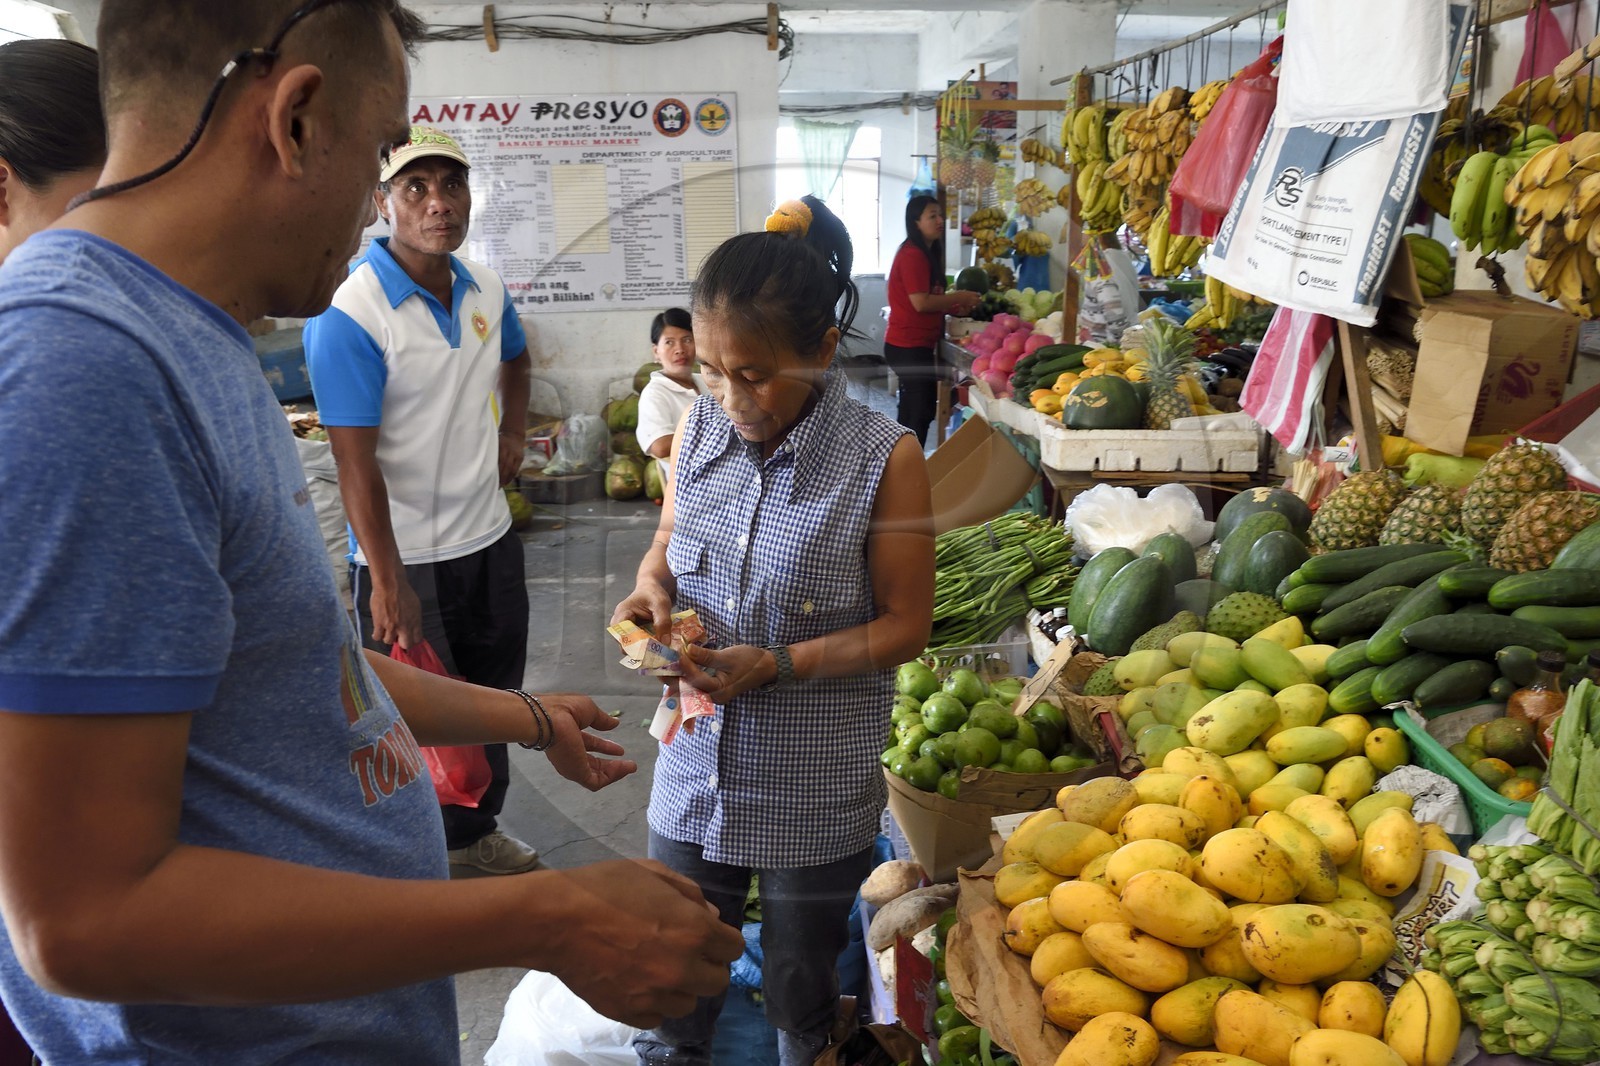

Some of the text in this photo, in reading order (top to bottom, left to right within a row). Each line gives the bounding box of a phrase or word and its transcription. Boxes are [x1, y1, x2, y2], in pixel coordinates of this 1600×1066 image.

[412, 102, 521, 125] ANTAY
[582, 151, 647, 159] DEPARTMENT
[1389, 118, 1425, 202] RapidSET
[1322, 234, 1341, 246] TYPE
[1357, 213, 1392, 296] RapidSET
[505, 281, 569, 291] ntayan ang
[1310, 276, 1337, 288] REPUBLIC
[528, 294, 549, 304] mga
[552, 292, 594, 302] Bilihin!
